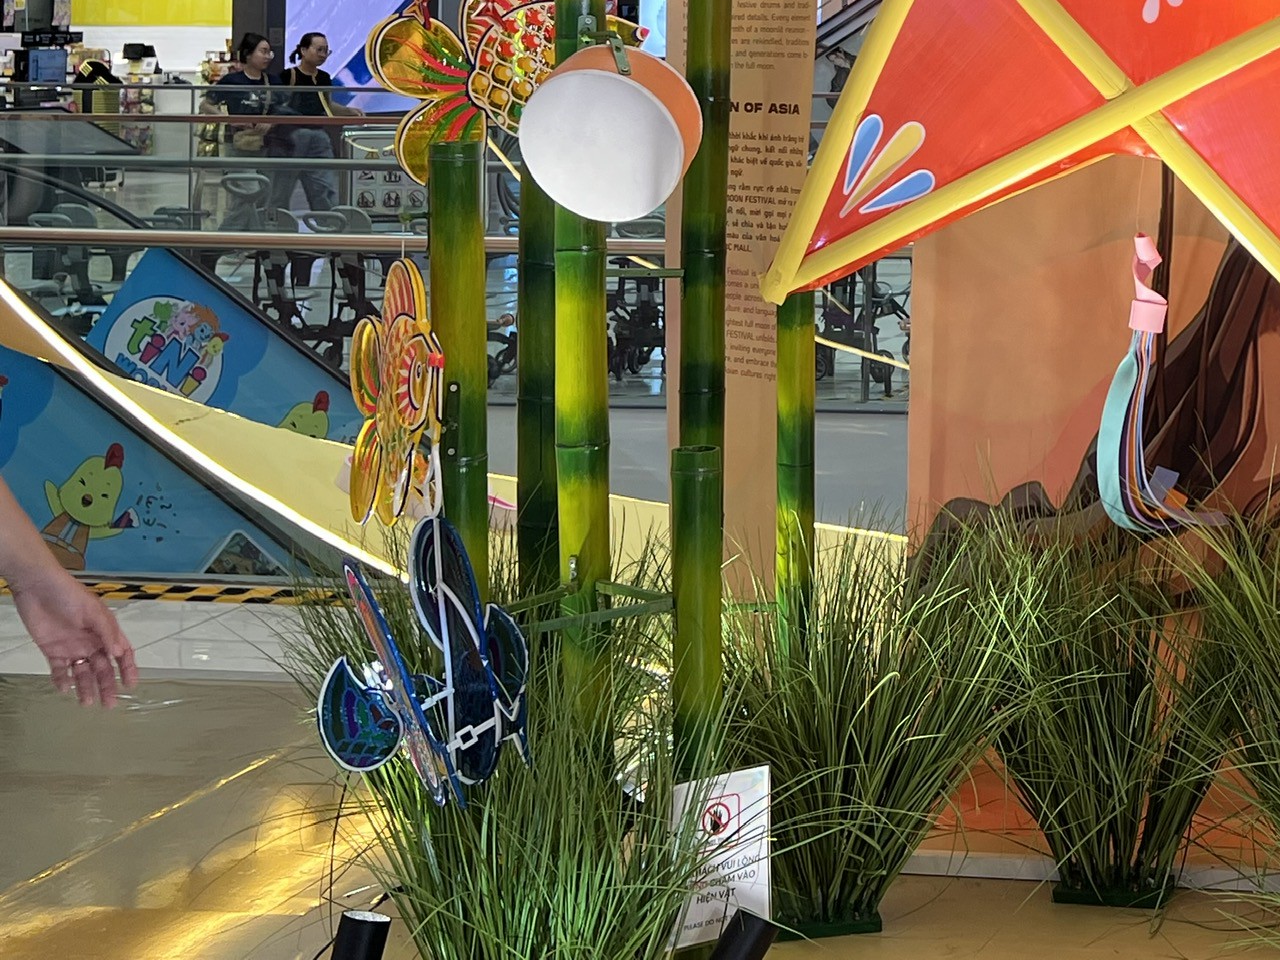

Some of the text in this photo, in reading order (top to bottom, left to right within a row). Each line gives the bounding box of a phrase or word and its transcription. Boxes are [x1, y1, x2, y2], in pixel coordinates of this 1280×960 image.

[744, 102, 763, 113] OF
[768, 103, 800, 115] ASIA
[745, 195, 776, 205] FESTIVAL
[737, 869, 756, 880] VÀO
[684, 922, 704, 931] PLEASE
